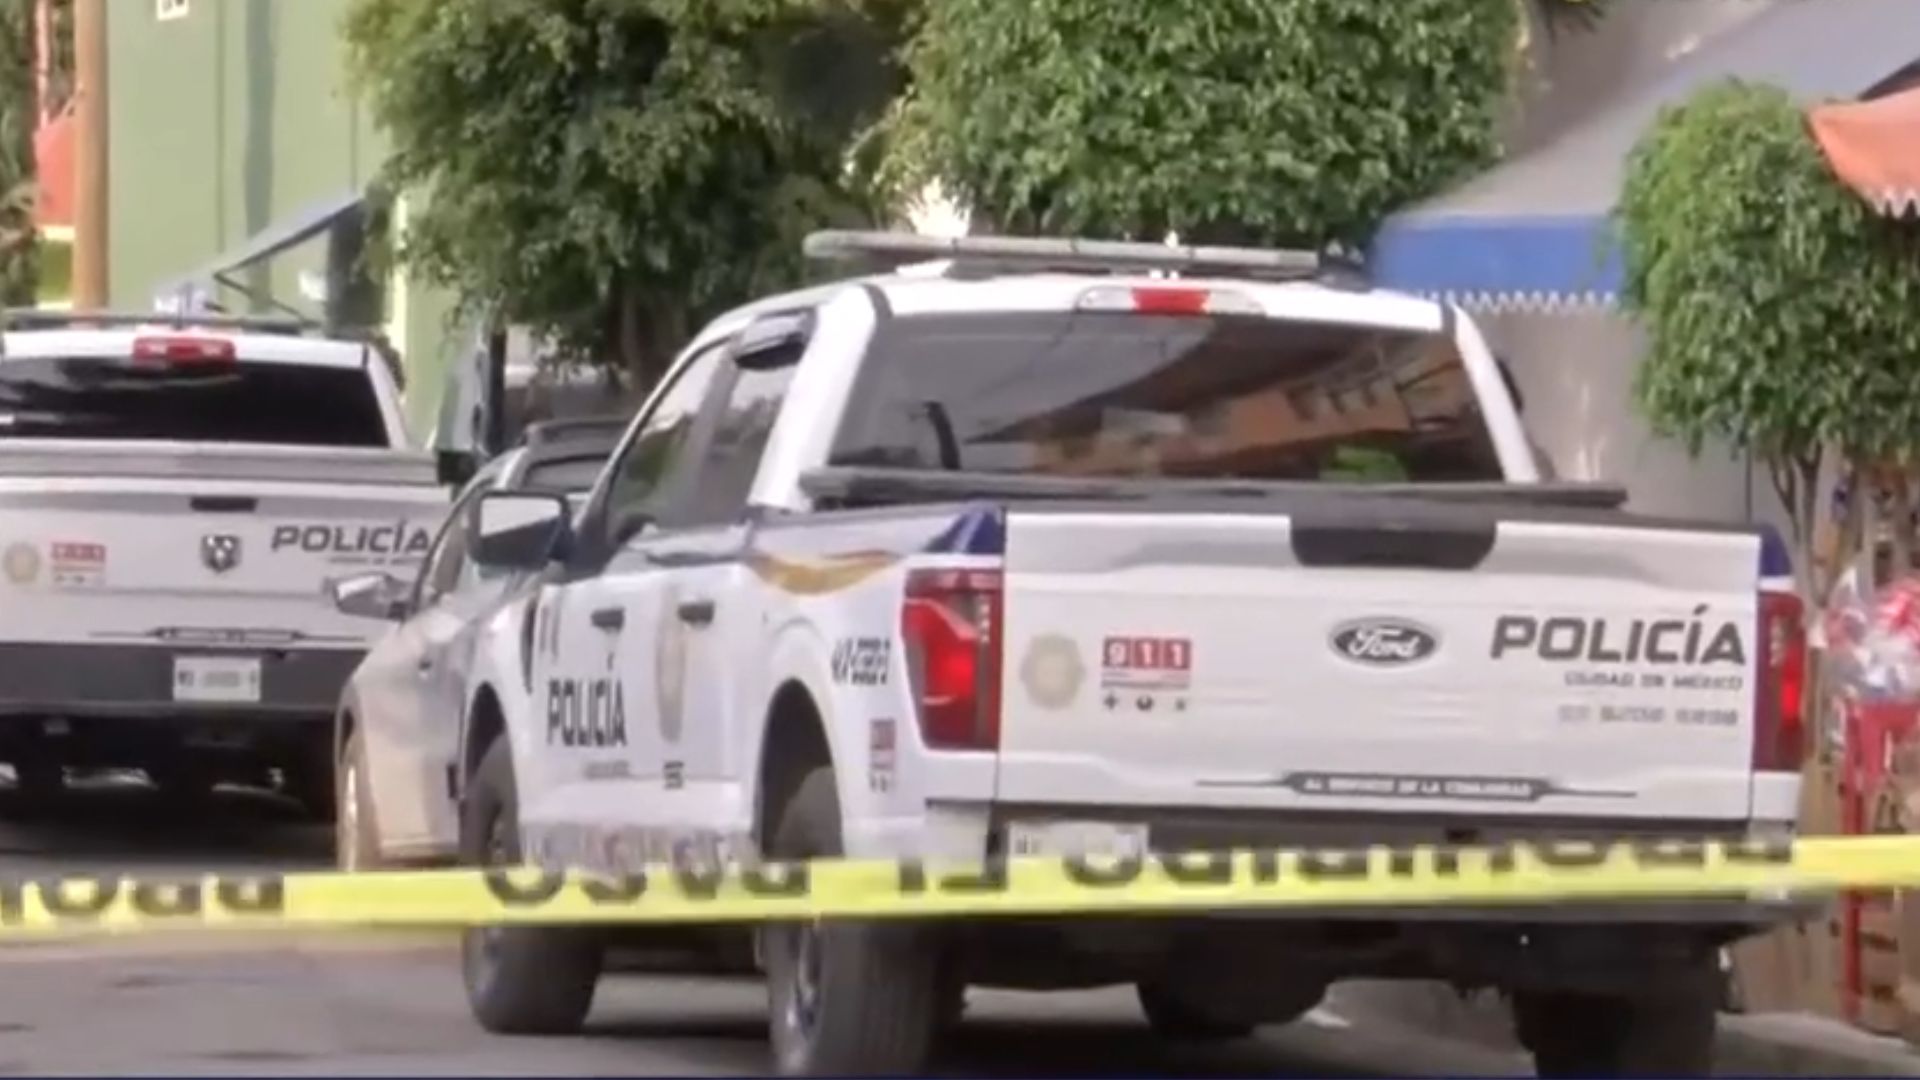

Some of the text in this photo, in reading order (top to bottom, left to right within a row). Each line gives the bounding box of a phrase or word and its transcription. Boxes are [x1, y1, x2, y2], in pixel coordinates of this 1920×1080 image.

[271, 517, 430, 553] POLICÍA
[1349, 627, 1419, 658] Ford
[1491, 604, 1746, 665] POLICÍA
[1109, 642, 1184, 668] 911
[547, 655, 627, 746] POLICÍA
